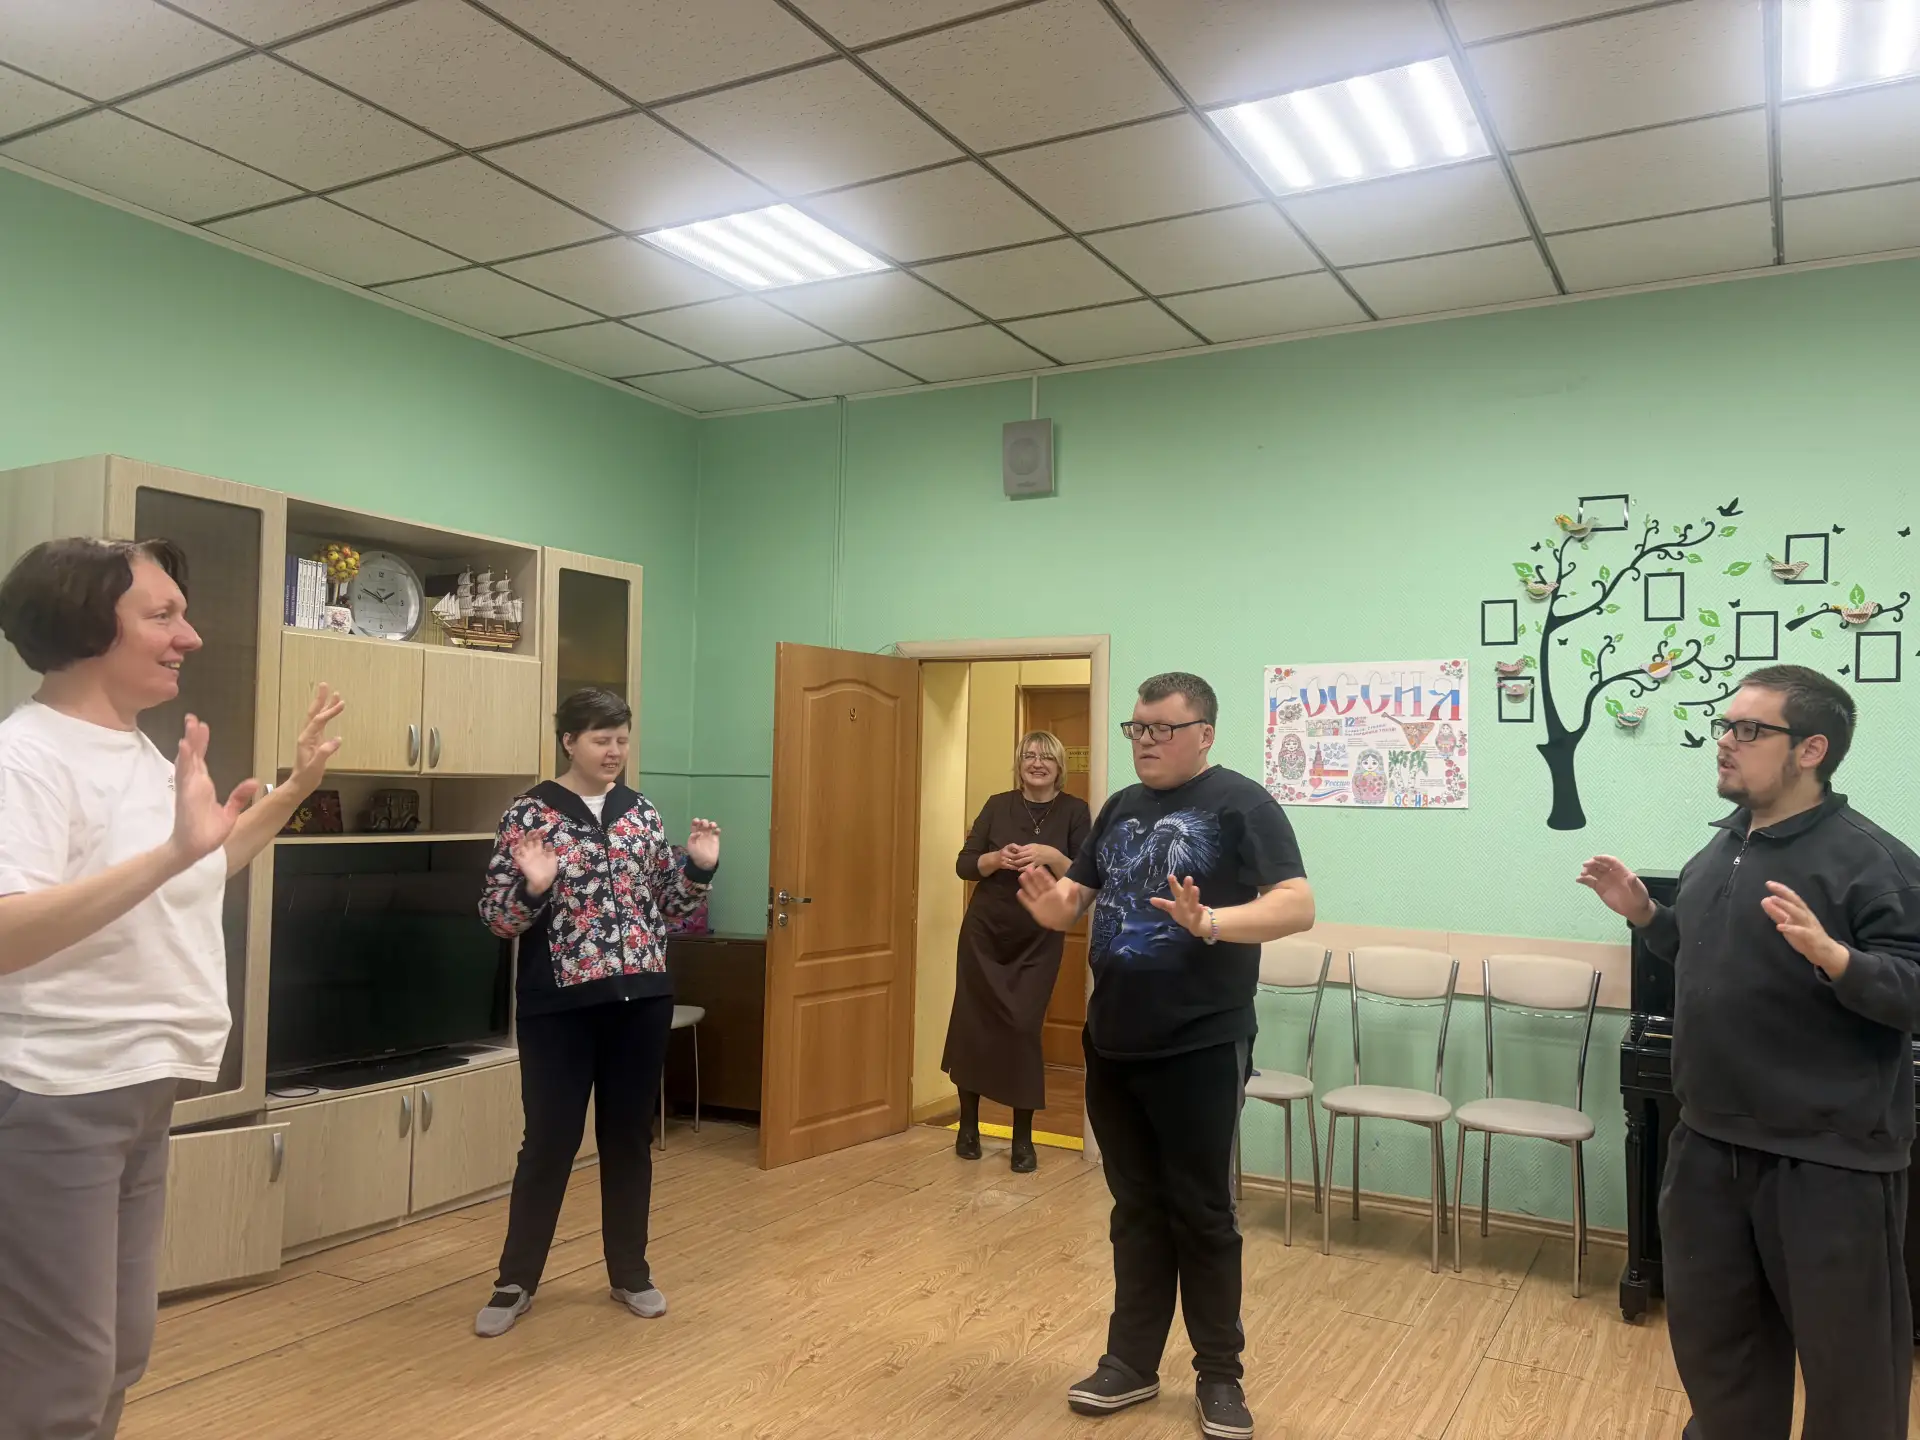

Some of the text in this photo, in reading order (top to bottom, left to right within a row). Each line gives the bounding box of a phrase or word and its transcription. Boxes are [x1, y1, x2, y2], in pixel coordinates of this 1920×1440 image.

[1268, 671, 1462, 726] РОССИЯ
[849, 708, 857, 722] 9
[1344, 717, 1355, 728] 12
[1388, 792, 1429, 807] РОСИЯ
